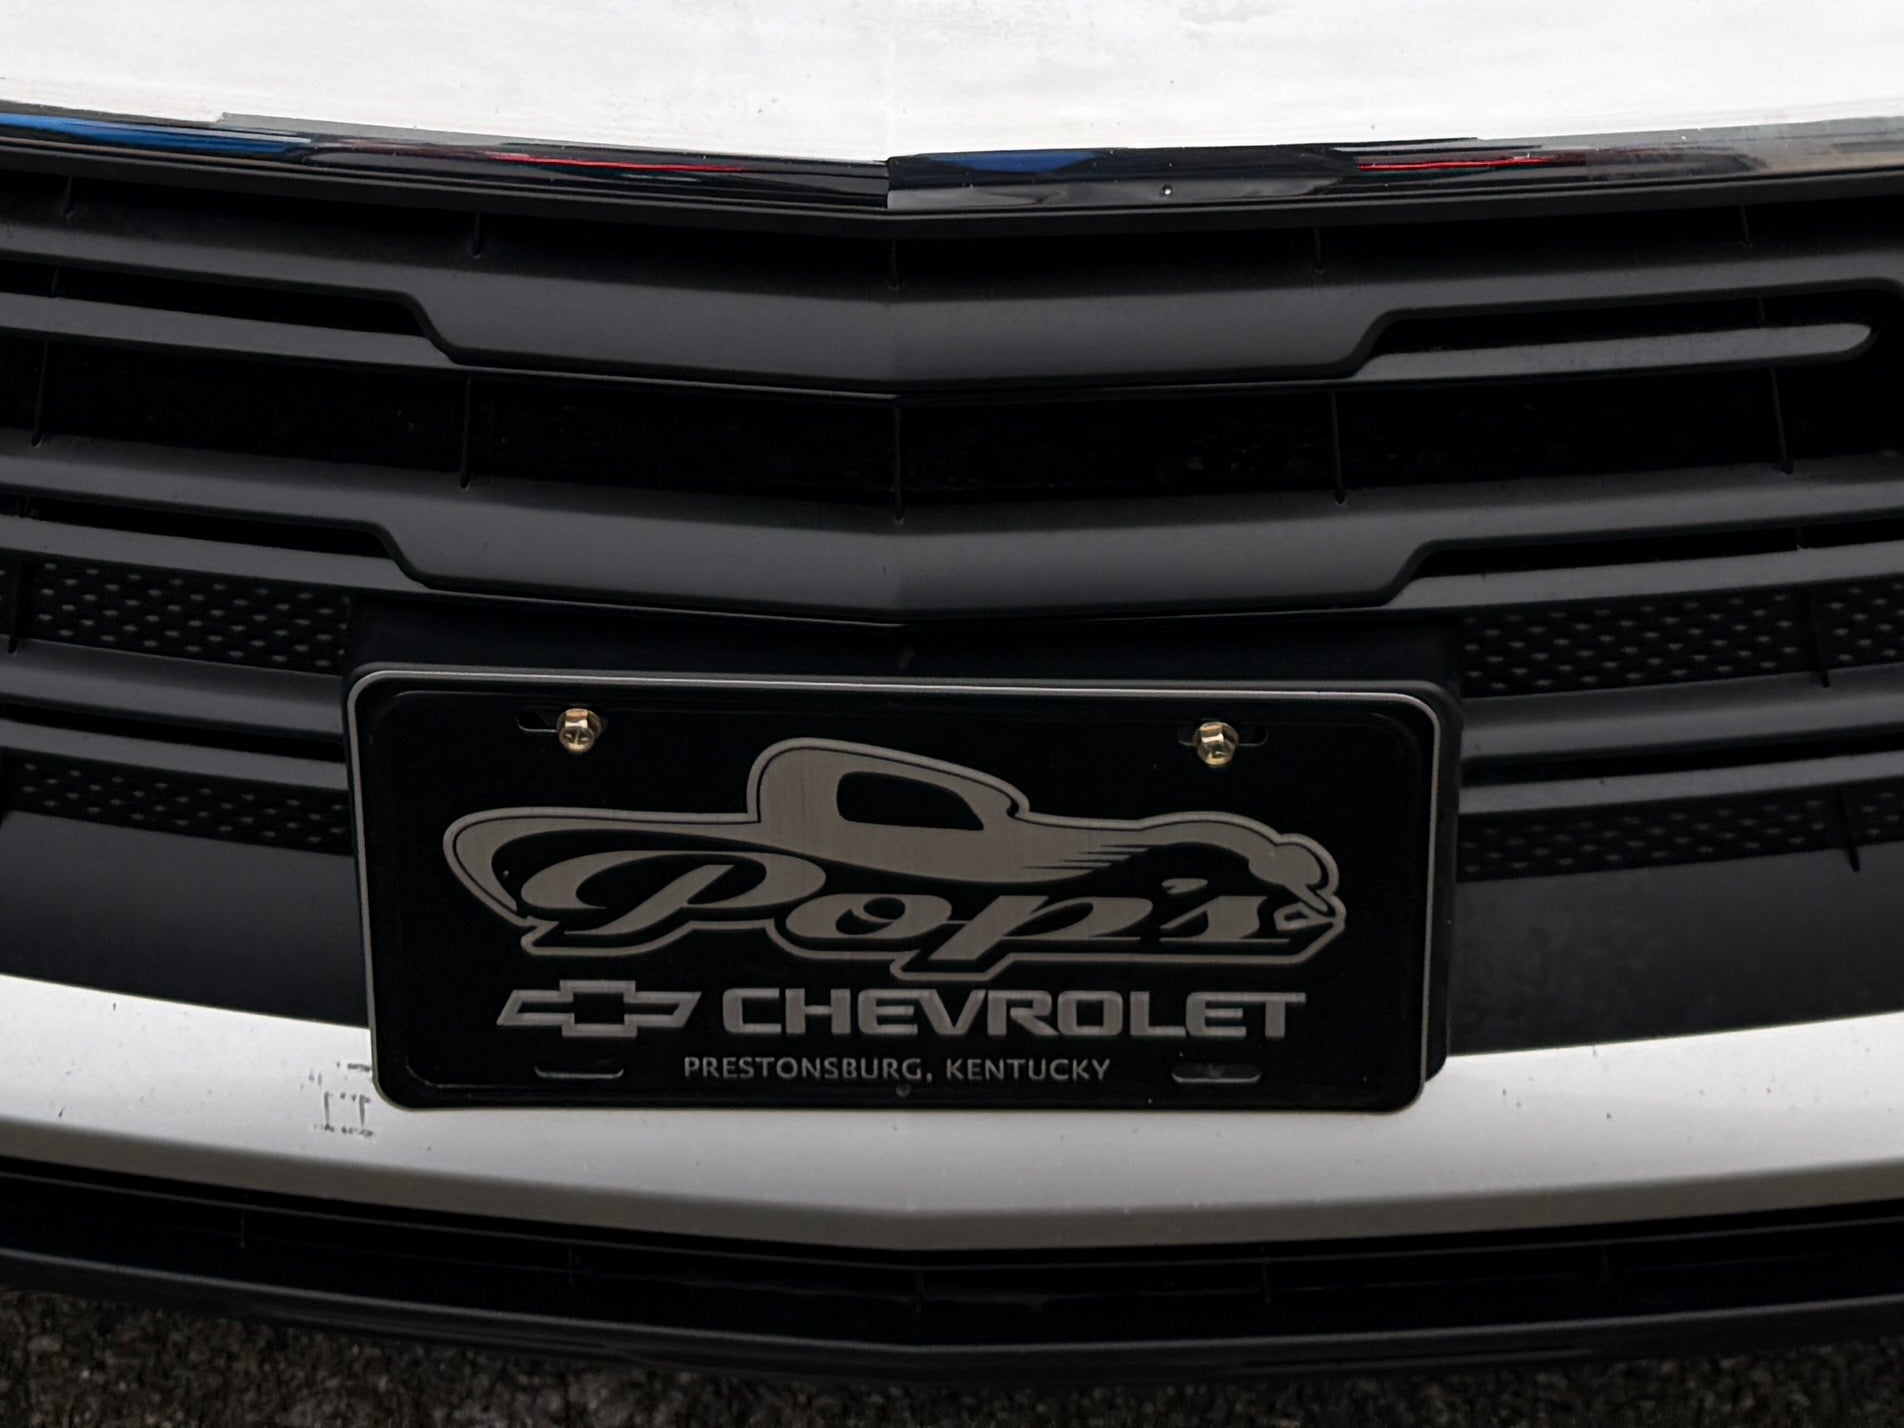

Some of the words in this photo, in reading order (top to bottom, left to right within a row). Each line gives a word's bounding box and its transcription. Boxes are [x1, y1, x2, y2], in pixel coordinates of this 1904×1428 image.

[521, 850, 1291, 962] Pop's
[721, 987, 1307, 1039] CHEVROLET
[683, 1056, 934, 1083] PRESTONSBURG,
[945, 1056, 1112, 1082] KENTUCKY
